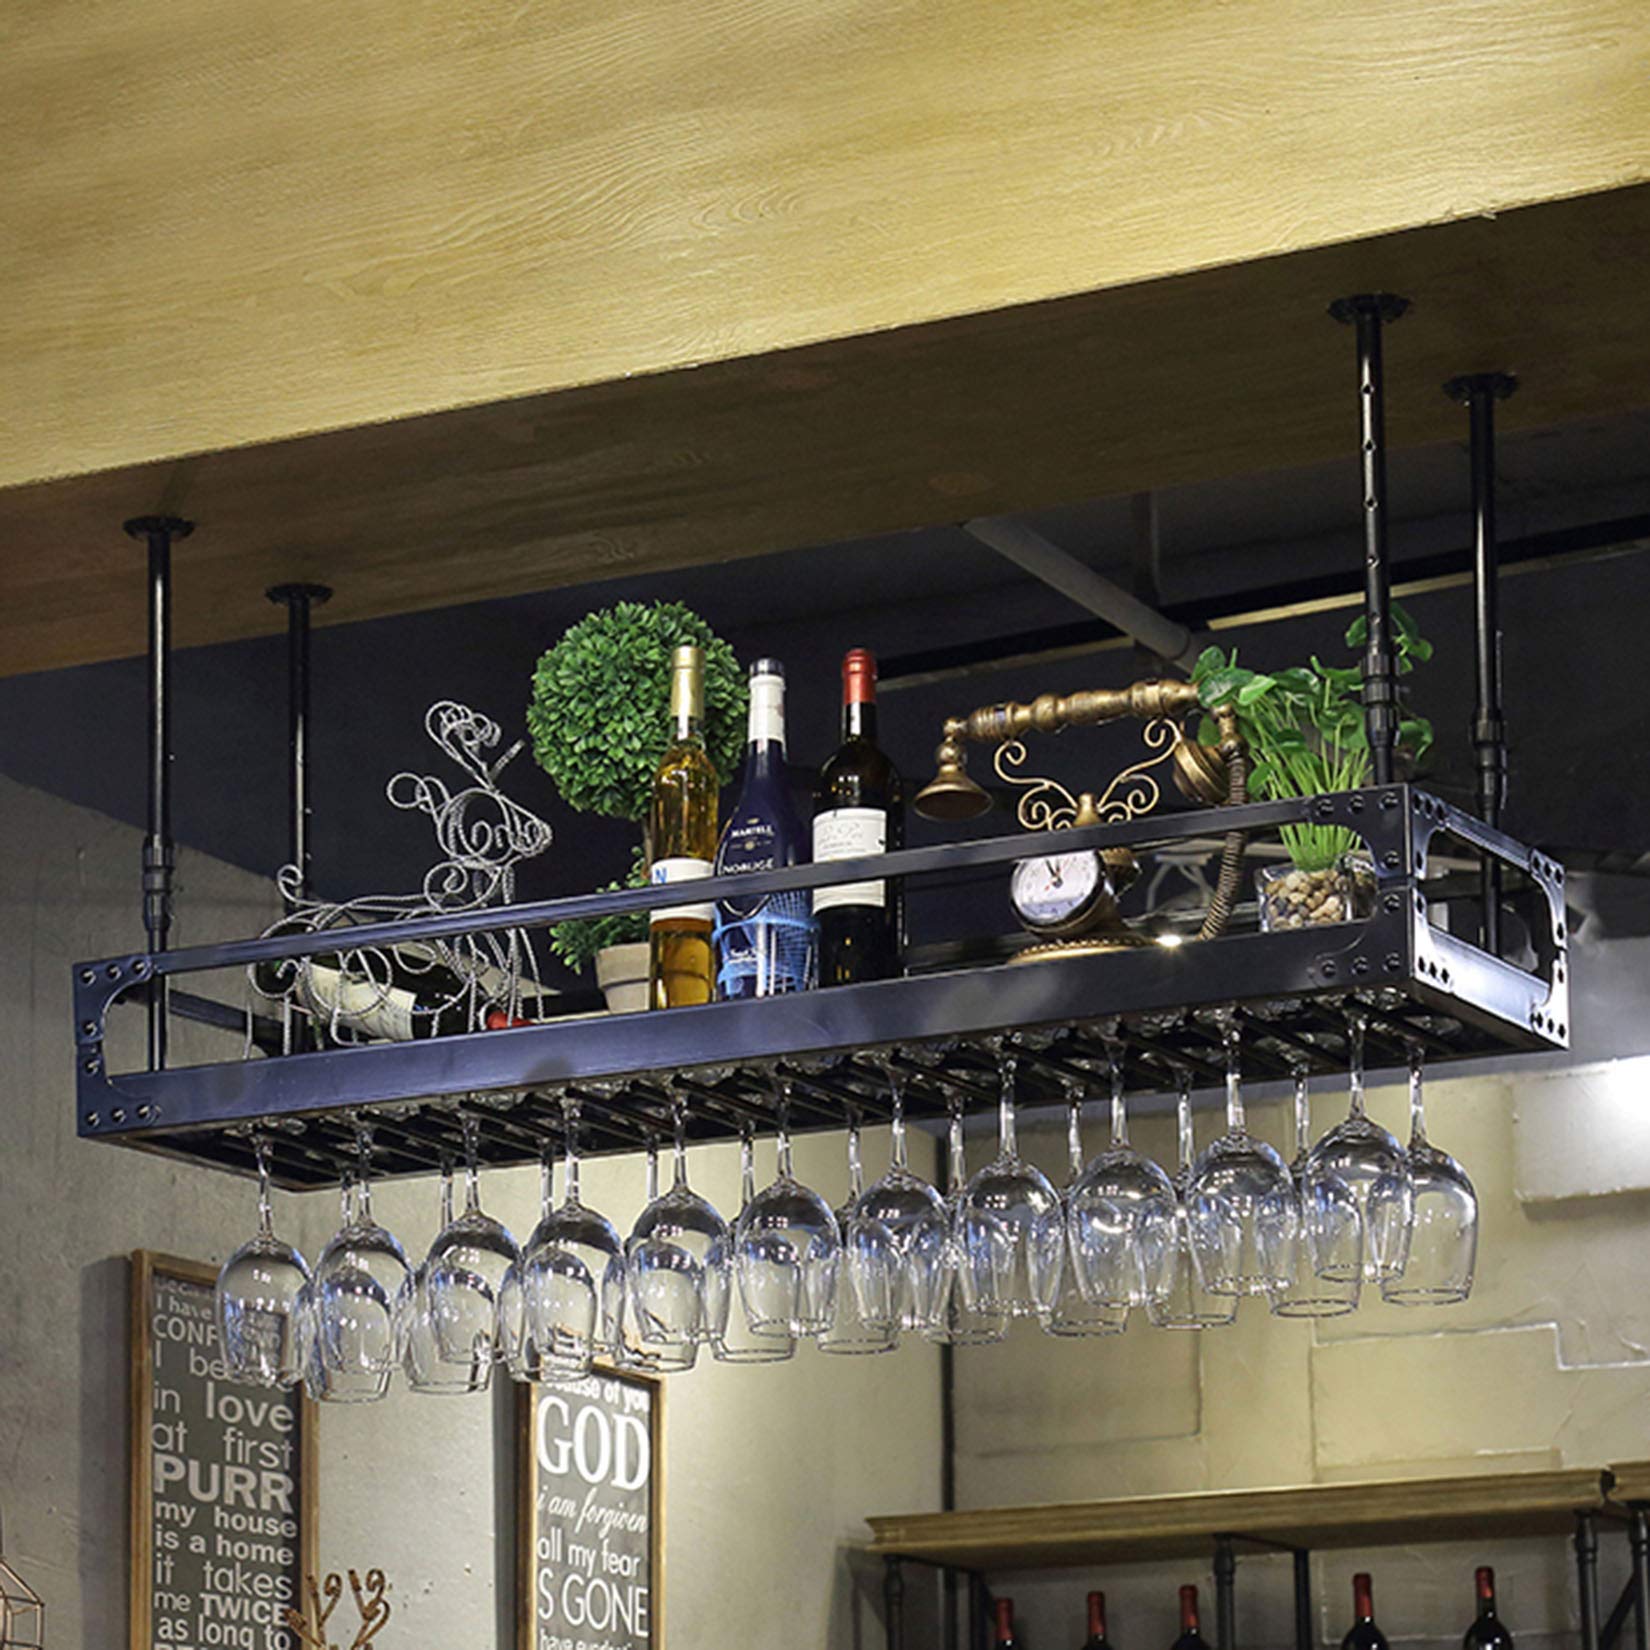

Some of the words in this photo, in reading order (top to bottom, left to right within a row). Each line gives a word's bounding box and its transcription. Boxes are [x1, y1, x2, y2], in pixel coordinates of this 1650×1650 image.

[169, 1295, 213, 1321] have
[153, 1314, 219, 1347] CONF
[155, 1340, 162, 1368] I
[153, 1381, 181, 1413] in
[206, 1381, 295, 1432] love
[622, 1386, 650, 1414] you
[152, 1420, 187, 1453] at
[223, 1427, 294, 1470] first
[537, 1395, 650, 1491] GOD
[153, 1453, 295, 1514] PURR
[154, 1500, 196, 1528] my
[213, 1505, 298, 1539] house
[548, 1495, 576, 1518] am
[574, 1487, 648, 1539] forgiven
[154, 1524, 180, 1550] is
[188, 1534, 206, 1554] a
[216, 1534, 295, 1565] home
[567, 1543, 597, 1578] my
[601, 1537, 641, 1577] fear
[156, 1552, 175, 1585] it
[203, 1561, 294, 1601] takes
[154, 1590, 192, 1612] me
[200, 1592, 292, 1627] TWICE
[538, 1567, 555, 1621] S
[561, 1572, 649, 1638] GONE
[157, 1616, 189, 1641] as
[198, 1614, 255, 1650] long
[264, 1624, 291, 1650] to
